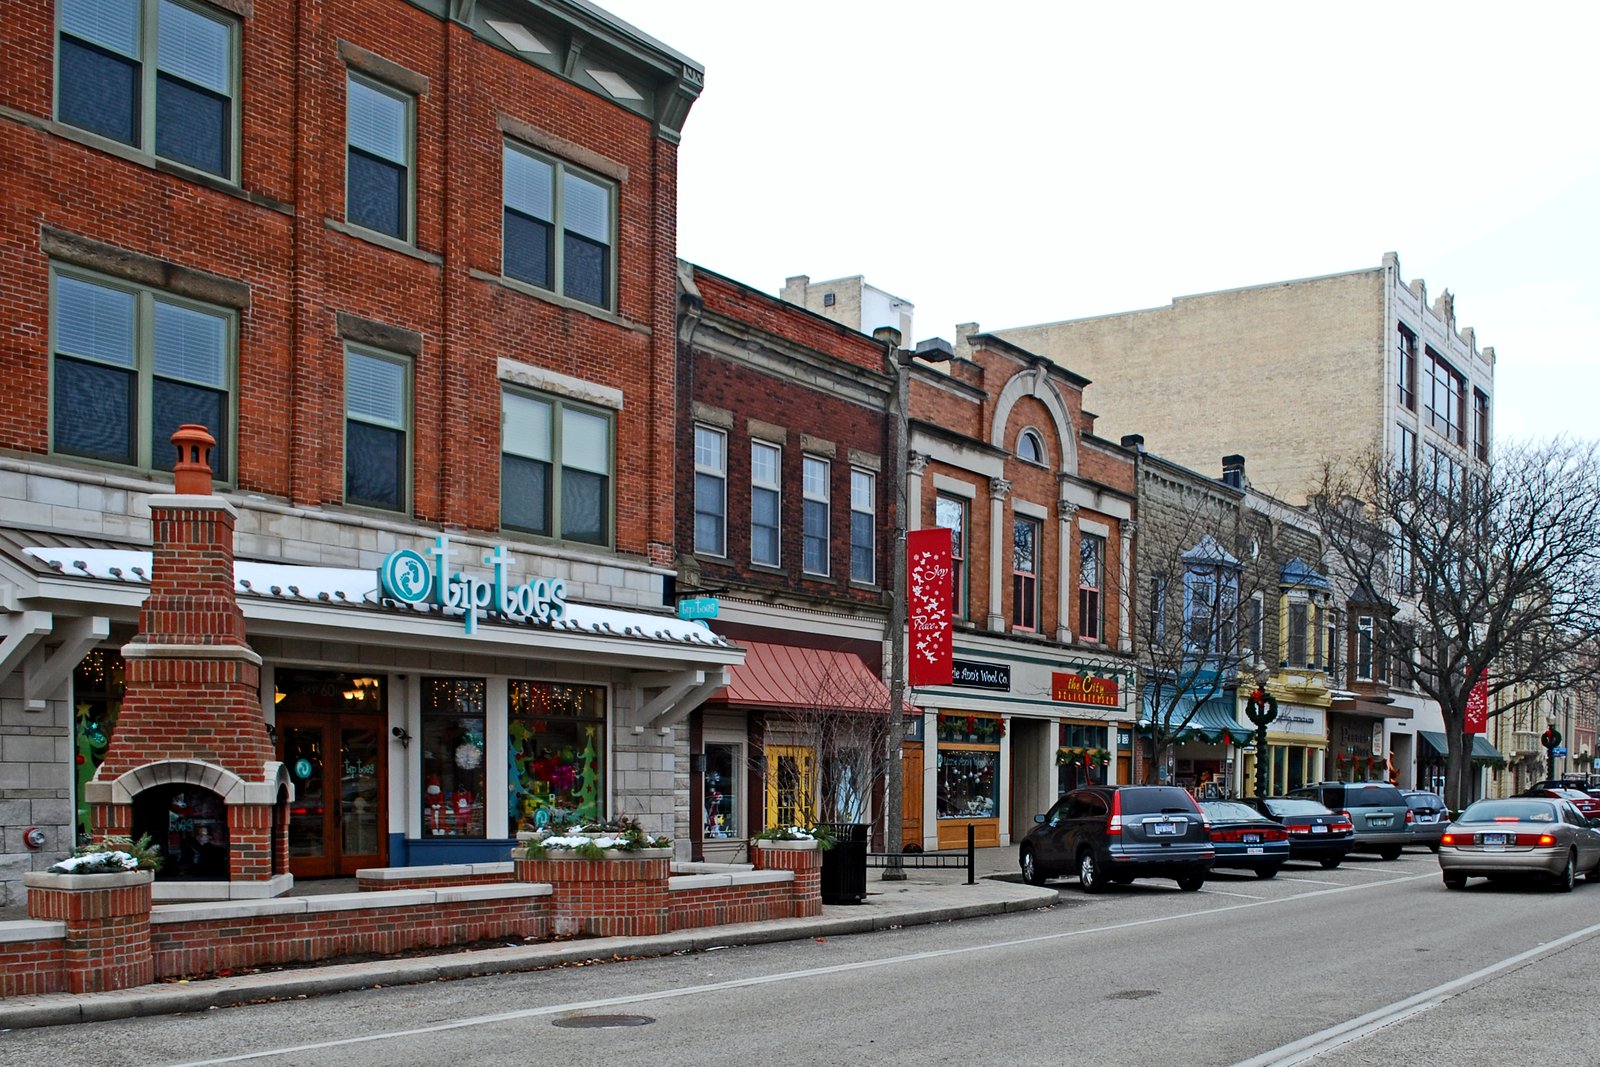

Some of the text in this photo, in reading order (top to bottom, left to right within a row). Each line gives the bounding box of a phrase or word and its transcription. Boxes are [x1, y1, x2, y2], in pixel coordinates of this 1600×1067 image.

[924, 564, 949, 580] Joy
[425, 535, 567, 634] tip toes
[680, 599, 715, 618] tip toes
[912, 615, 935, 630] Peace
[980, 669, 998, 683] Wool
[1067, 675, 1104, 697] the City
[344, 758, 375, 779] tip toes
